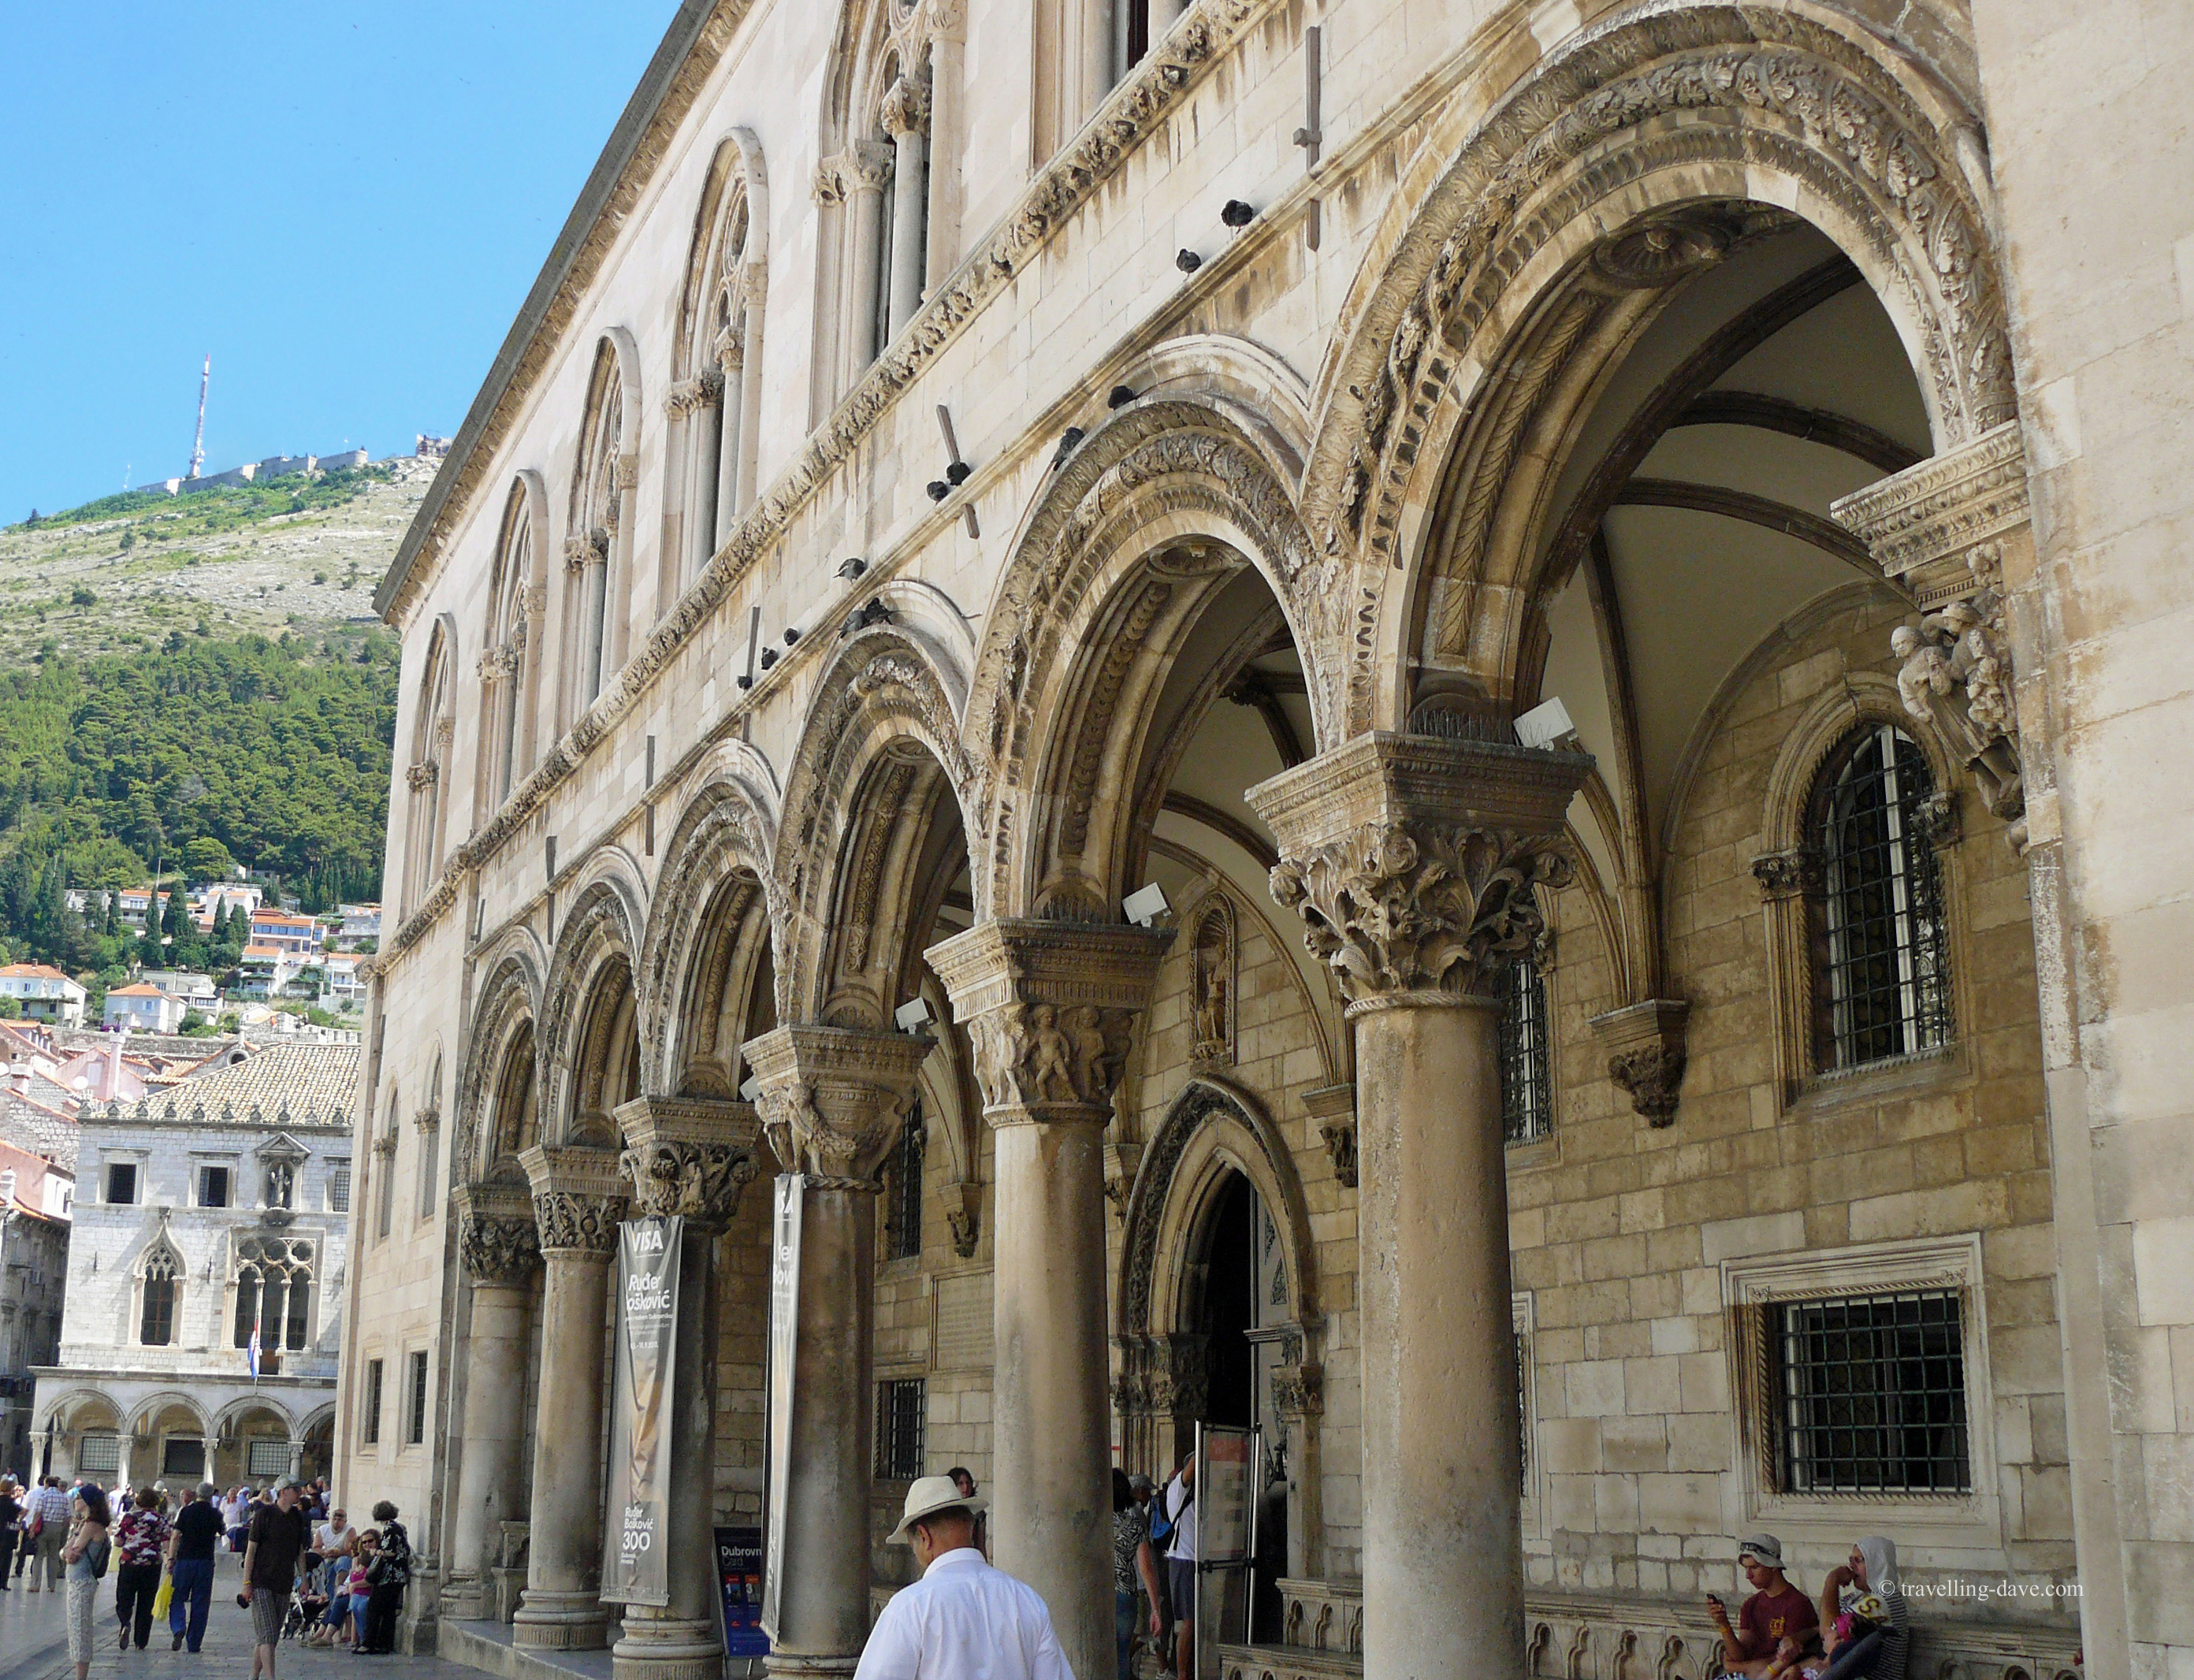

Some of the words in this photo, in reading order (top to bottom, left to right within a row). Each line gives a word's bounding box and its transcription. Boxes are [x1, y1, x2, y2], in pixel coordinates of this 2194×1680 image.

[631, 1230, 664, 1252] VISA
[627, 1289, 670, 1310] ošković
[622, 1531, 650, 1551] 300
[721, 1545, 762, 1556] Dubrovn
[726, 1583, 731, 1594] 1
[746, 1583, 753, 1593] 3
